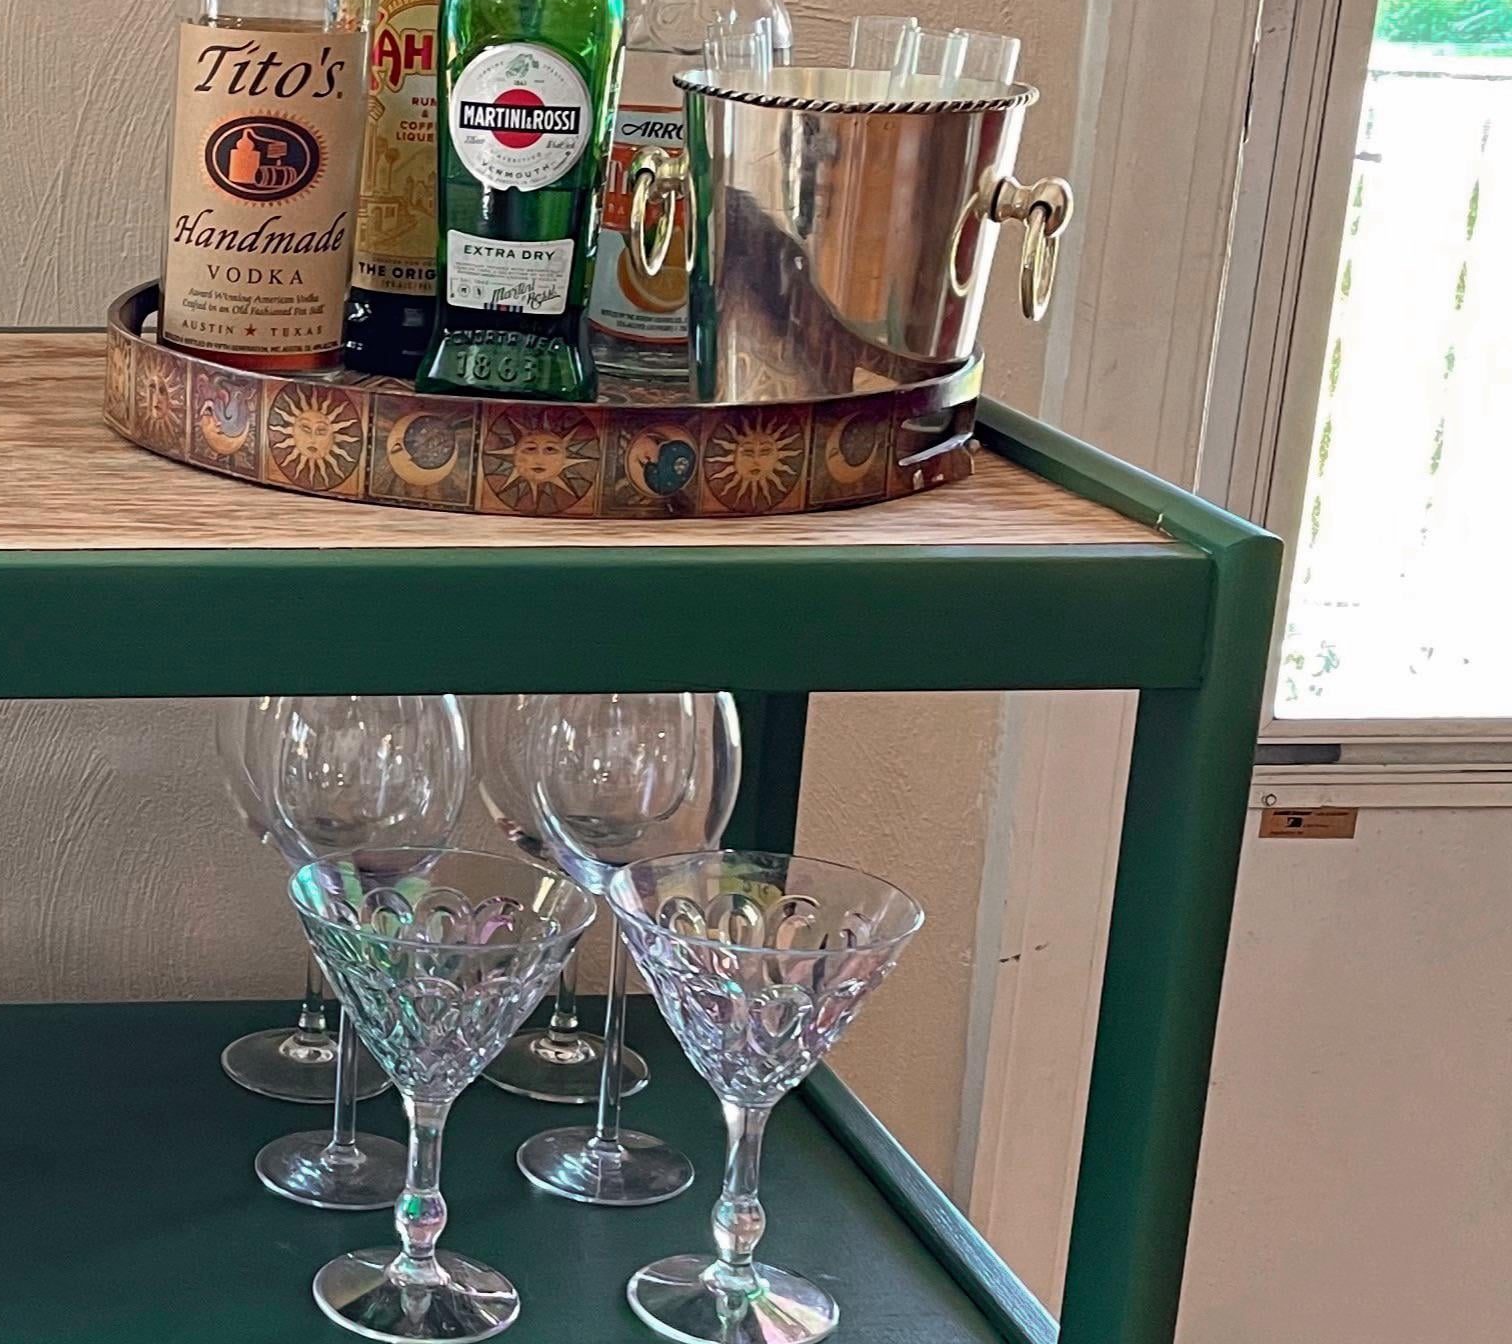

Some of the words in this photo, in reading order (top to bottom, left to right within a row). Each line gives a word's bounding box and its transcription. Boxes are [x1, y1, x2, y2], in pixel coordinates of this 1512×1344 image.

[194, 39, 345, 99] Tito's
[400, 121, 434, 131] COFF
[396, 131, 434, 142] LIQUE
[173, 208, 348, 255] Handmade
[463, 244, 516, 260] EXTRA
[521, 249, 556, 261] DRY
[207, 264, 304, 286] VODKA
[358, 261, 387, 276] THE
[392, 267, 436, 280] ORIG
[254, 295, 295, 304] American
[297, 293, 319, 304] Vodka
[232, 304, 248, 314] Old
[250, 306, 292, 316] Fashioned
[182, 319, 235, 335] AUSTIN
[271, 325, 324, 337] TEXAS
[455, 351, 537, 382] 1863
